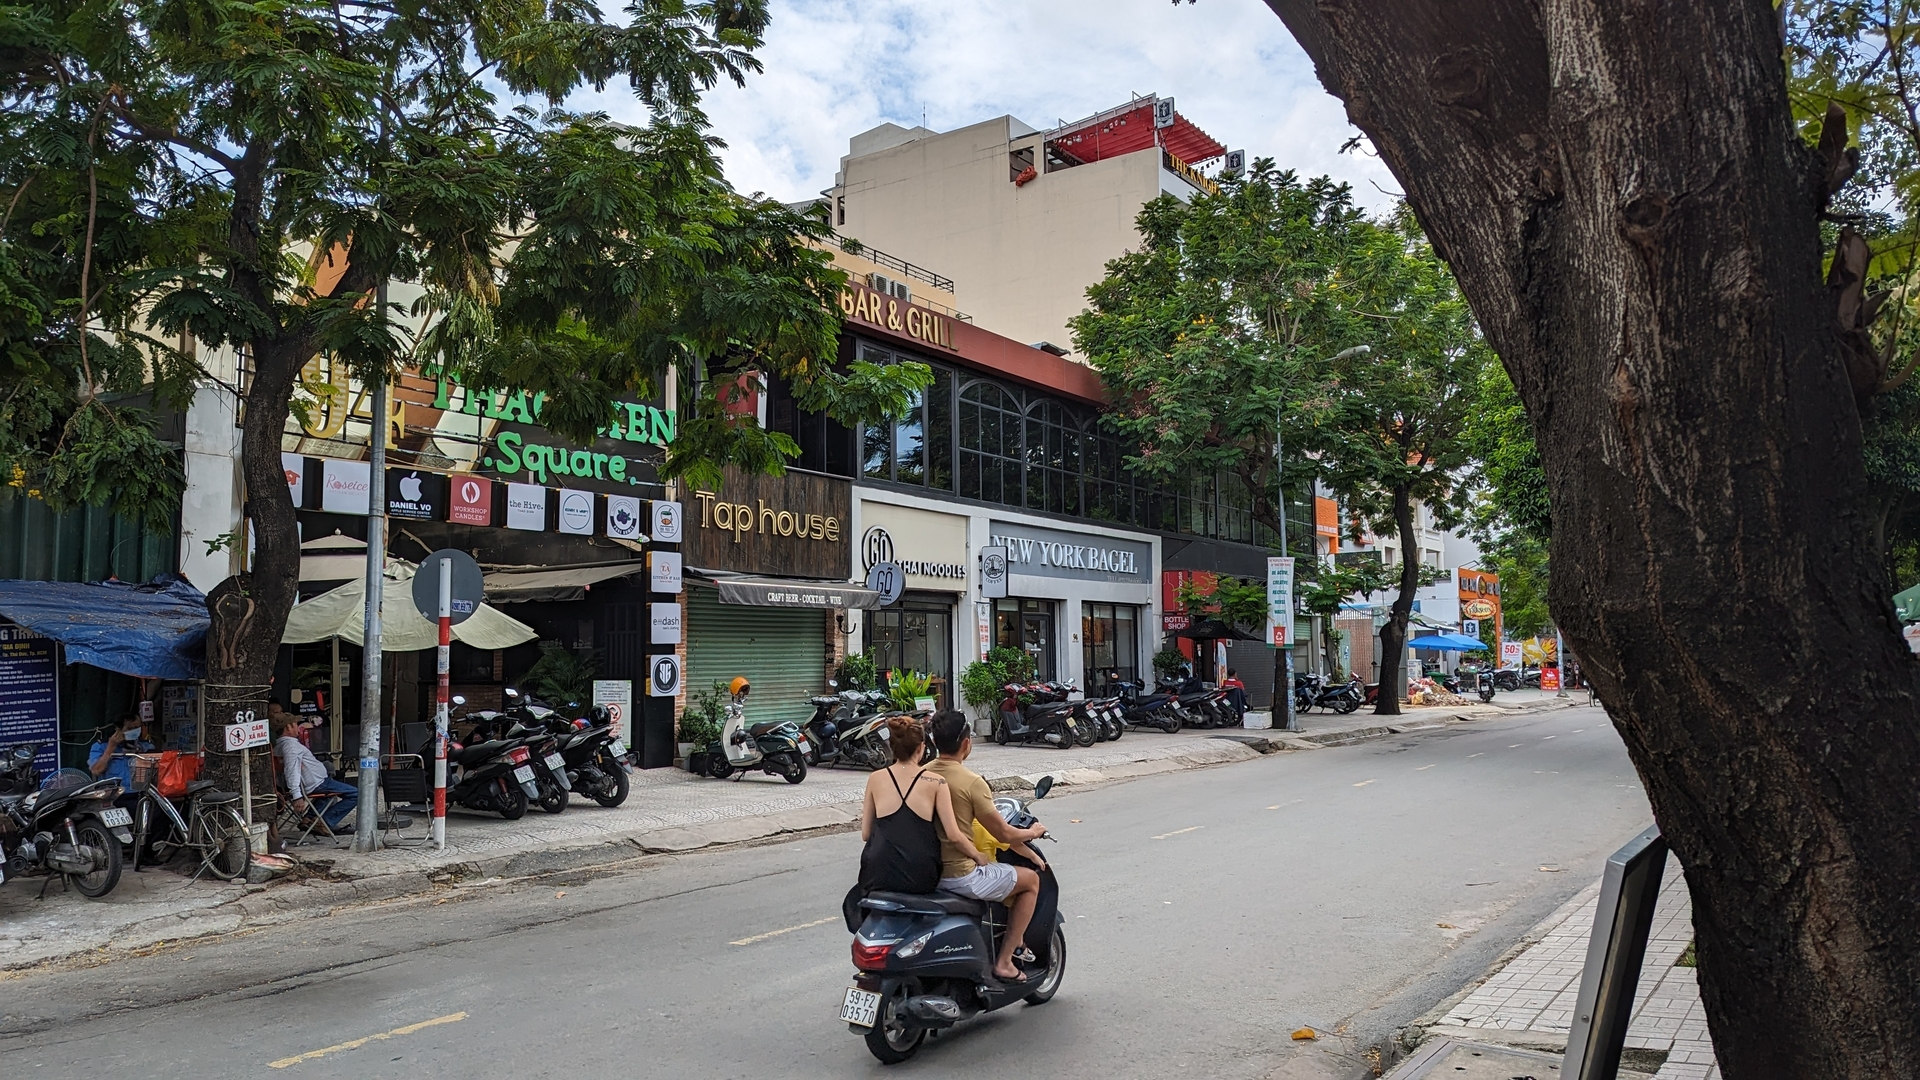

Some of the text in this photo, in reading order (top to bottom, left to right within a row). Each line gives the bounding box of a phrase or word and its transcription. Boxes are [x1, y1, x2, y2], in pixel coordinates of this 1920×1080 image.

[1170, 153, 1187, 173] THE
[841, 285, 883, 326] BAR
[888, 300, 903, 331] &
[906, 307, 959, 352] GRILL
[390, 501, 418, 510] DANIEL
[454, 506, 487, 515] WORKSHOP
[509, 500, 543, 510] the Hive.
[695, 490, 840, 543] Tap house
[1038, 541, 1086, 569] YORK
[1087, 547, 1138, 574] BAGEL
[896, 560, 967, 578] THAI NOODLES
[768, 592, 784, 602] CRAFT
[785, 593, 798, 603] BEER
[802, 594, 826, 604] COCKTAIL
[830, 596, 842, 605] WINE
[235, 710, 255, 724] 60
[249, 732, 256, 740] XẢ
[842, 1005, 875, 1024] 035.70
